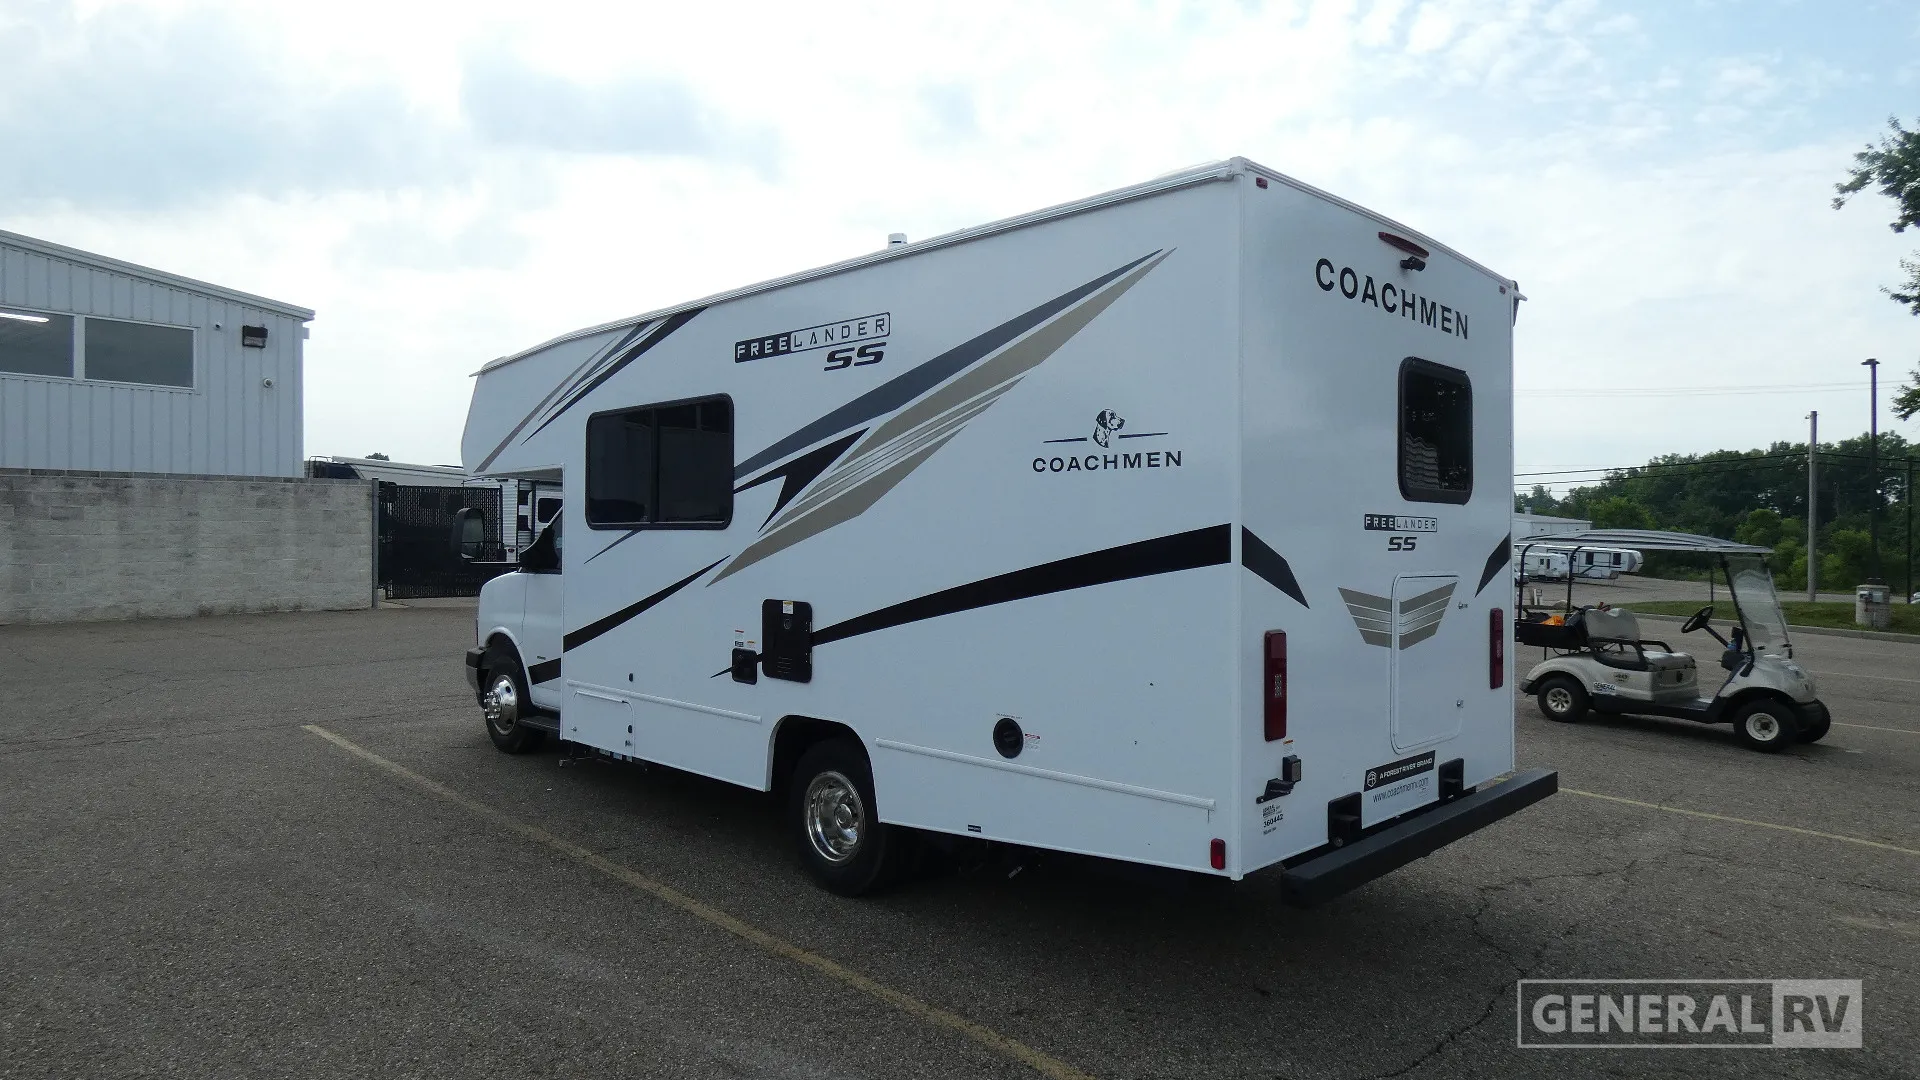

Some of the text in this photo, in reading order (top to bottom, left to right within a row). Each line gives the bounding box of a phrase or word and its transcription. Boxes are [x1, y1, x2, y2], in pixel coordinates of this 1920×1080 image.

[1315, 258, 1468, 340] COACHMEN
[737, 317, 885, 359] FREELANDER
[823, 341, 887, 371] SS
[1032, 450, 1182, 473] COACHMEN
[1365, 516, 1436, 530] FREELANDER
[1387, 536, 1418, 551] SS
